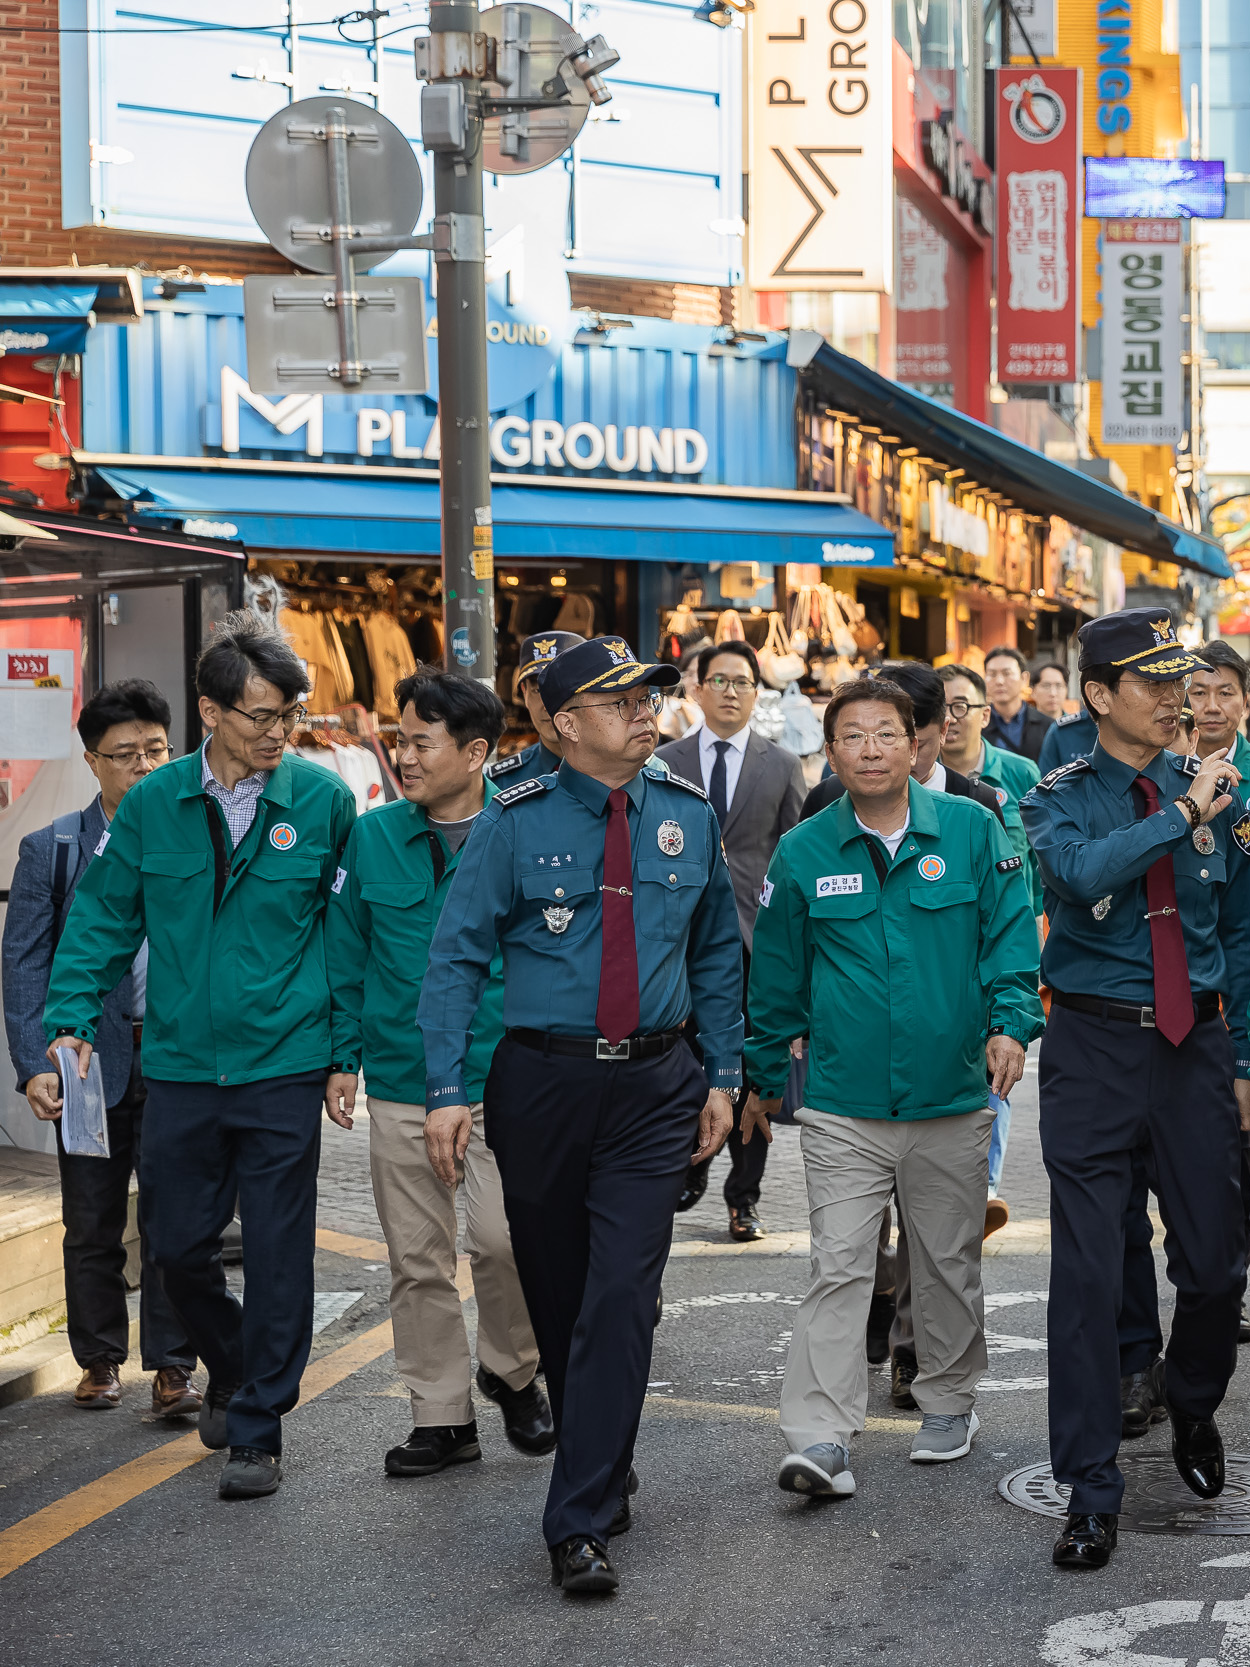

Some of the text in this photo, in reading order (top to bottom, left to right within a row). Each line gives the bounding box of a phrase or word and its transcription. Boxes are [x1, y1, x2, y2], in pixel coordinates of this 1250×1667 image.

[1036, 179, 1059, 302] 엽기떡볶이
[1120, 253, 1163, 416] 영동교집
[357, 407, 708, 475] PLGROUND
